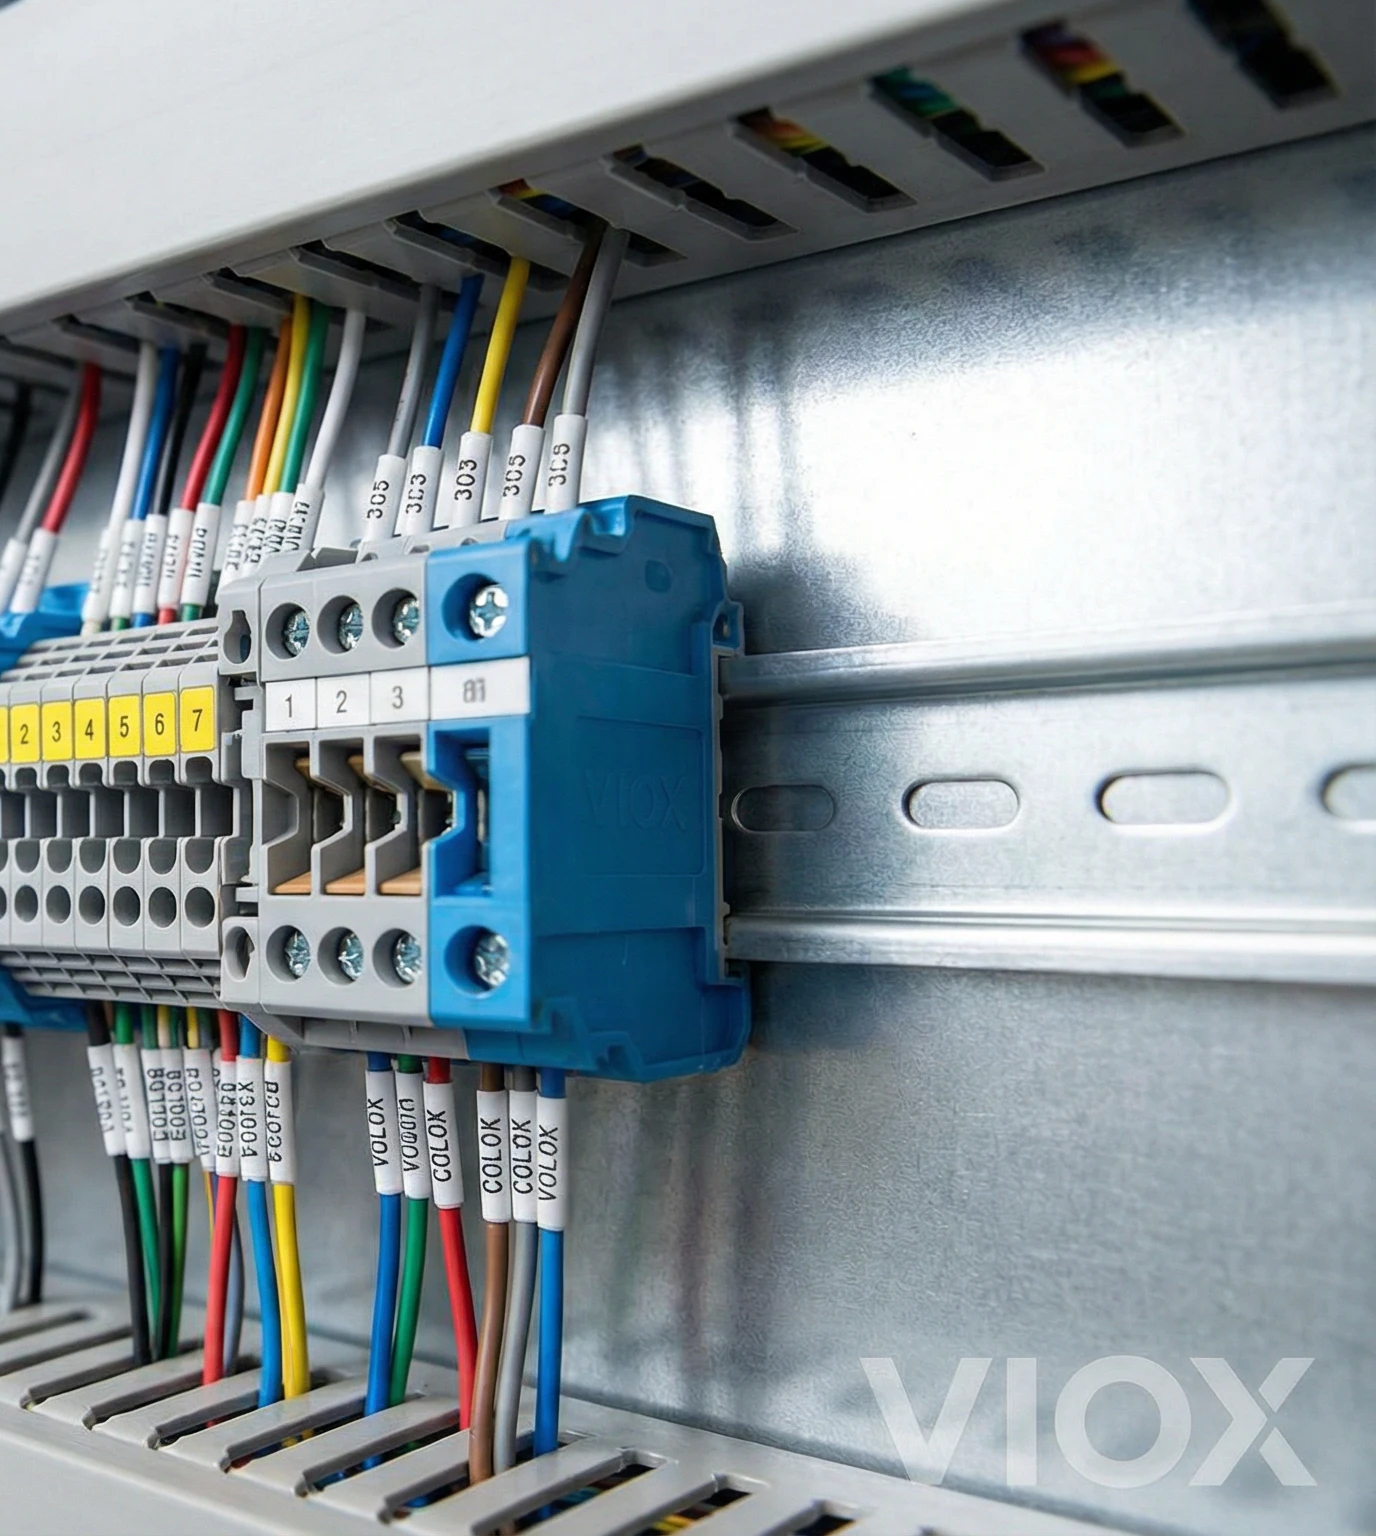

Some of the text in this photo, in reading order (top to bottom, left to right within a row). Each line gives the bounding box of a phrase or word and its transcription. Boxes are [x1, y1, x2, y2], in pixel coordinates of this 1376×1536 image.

[453, 459, 478, 501] 303
[366, 480, 390, 519] 305
[284, 694, 293, 718] 1
[335, 690, 348, 714] 2
[391, 685, 404, 710] 3
[52, 721, 62, 742] 3
[84, 718, 94, 741] 4
[119, 715, 130, 738] 5
[154, 712, 165, 736] 6
[192, 708, 203, 732] 7
[19, 724, 29, 745] 2
[583, 769, 688, 832] VIOX
[367, 1098, 389, 1167] VOLOX
[479, 1117, 503, 1194] COLOK
[538, 1124, 559, 1201] VOLOX
